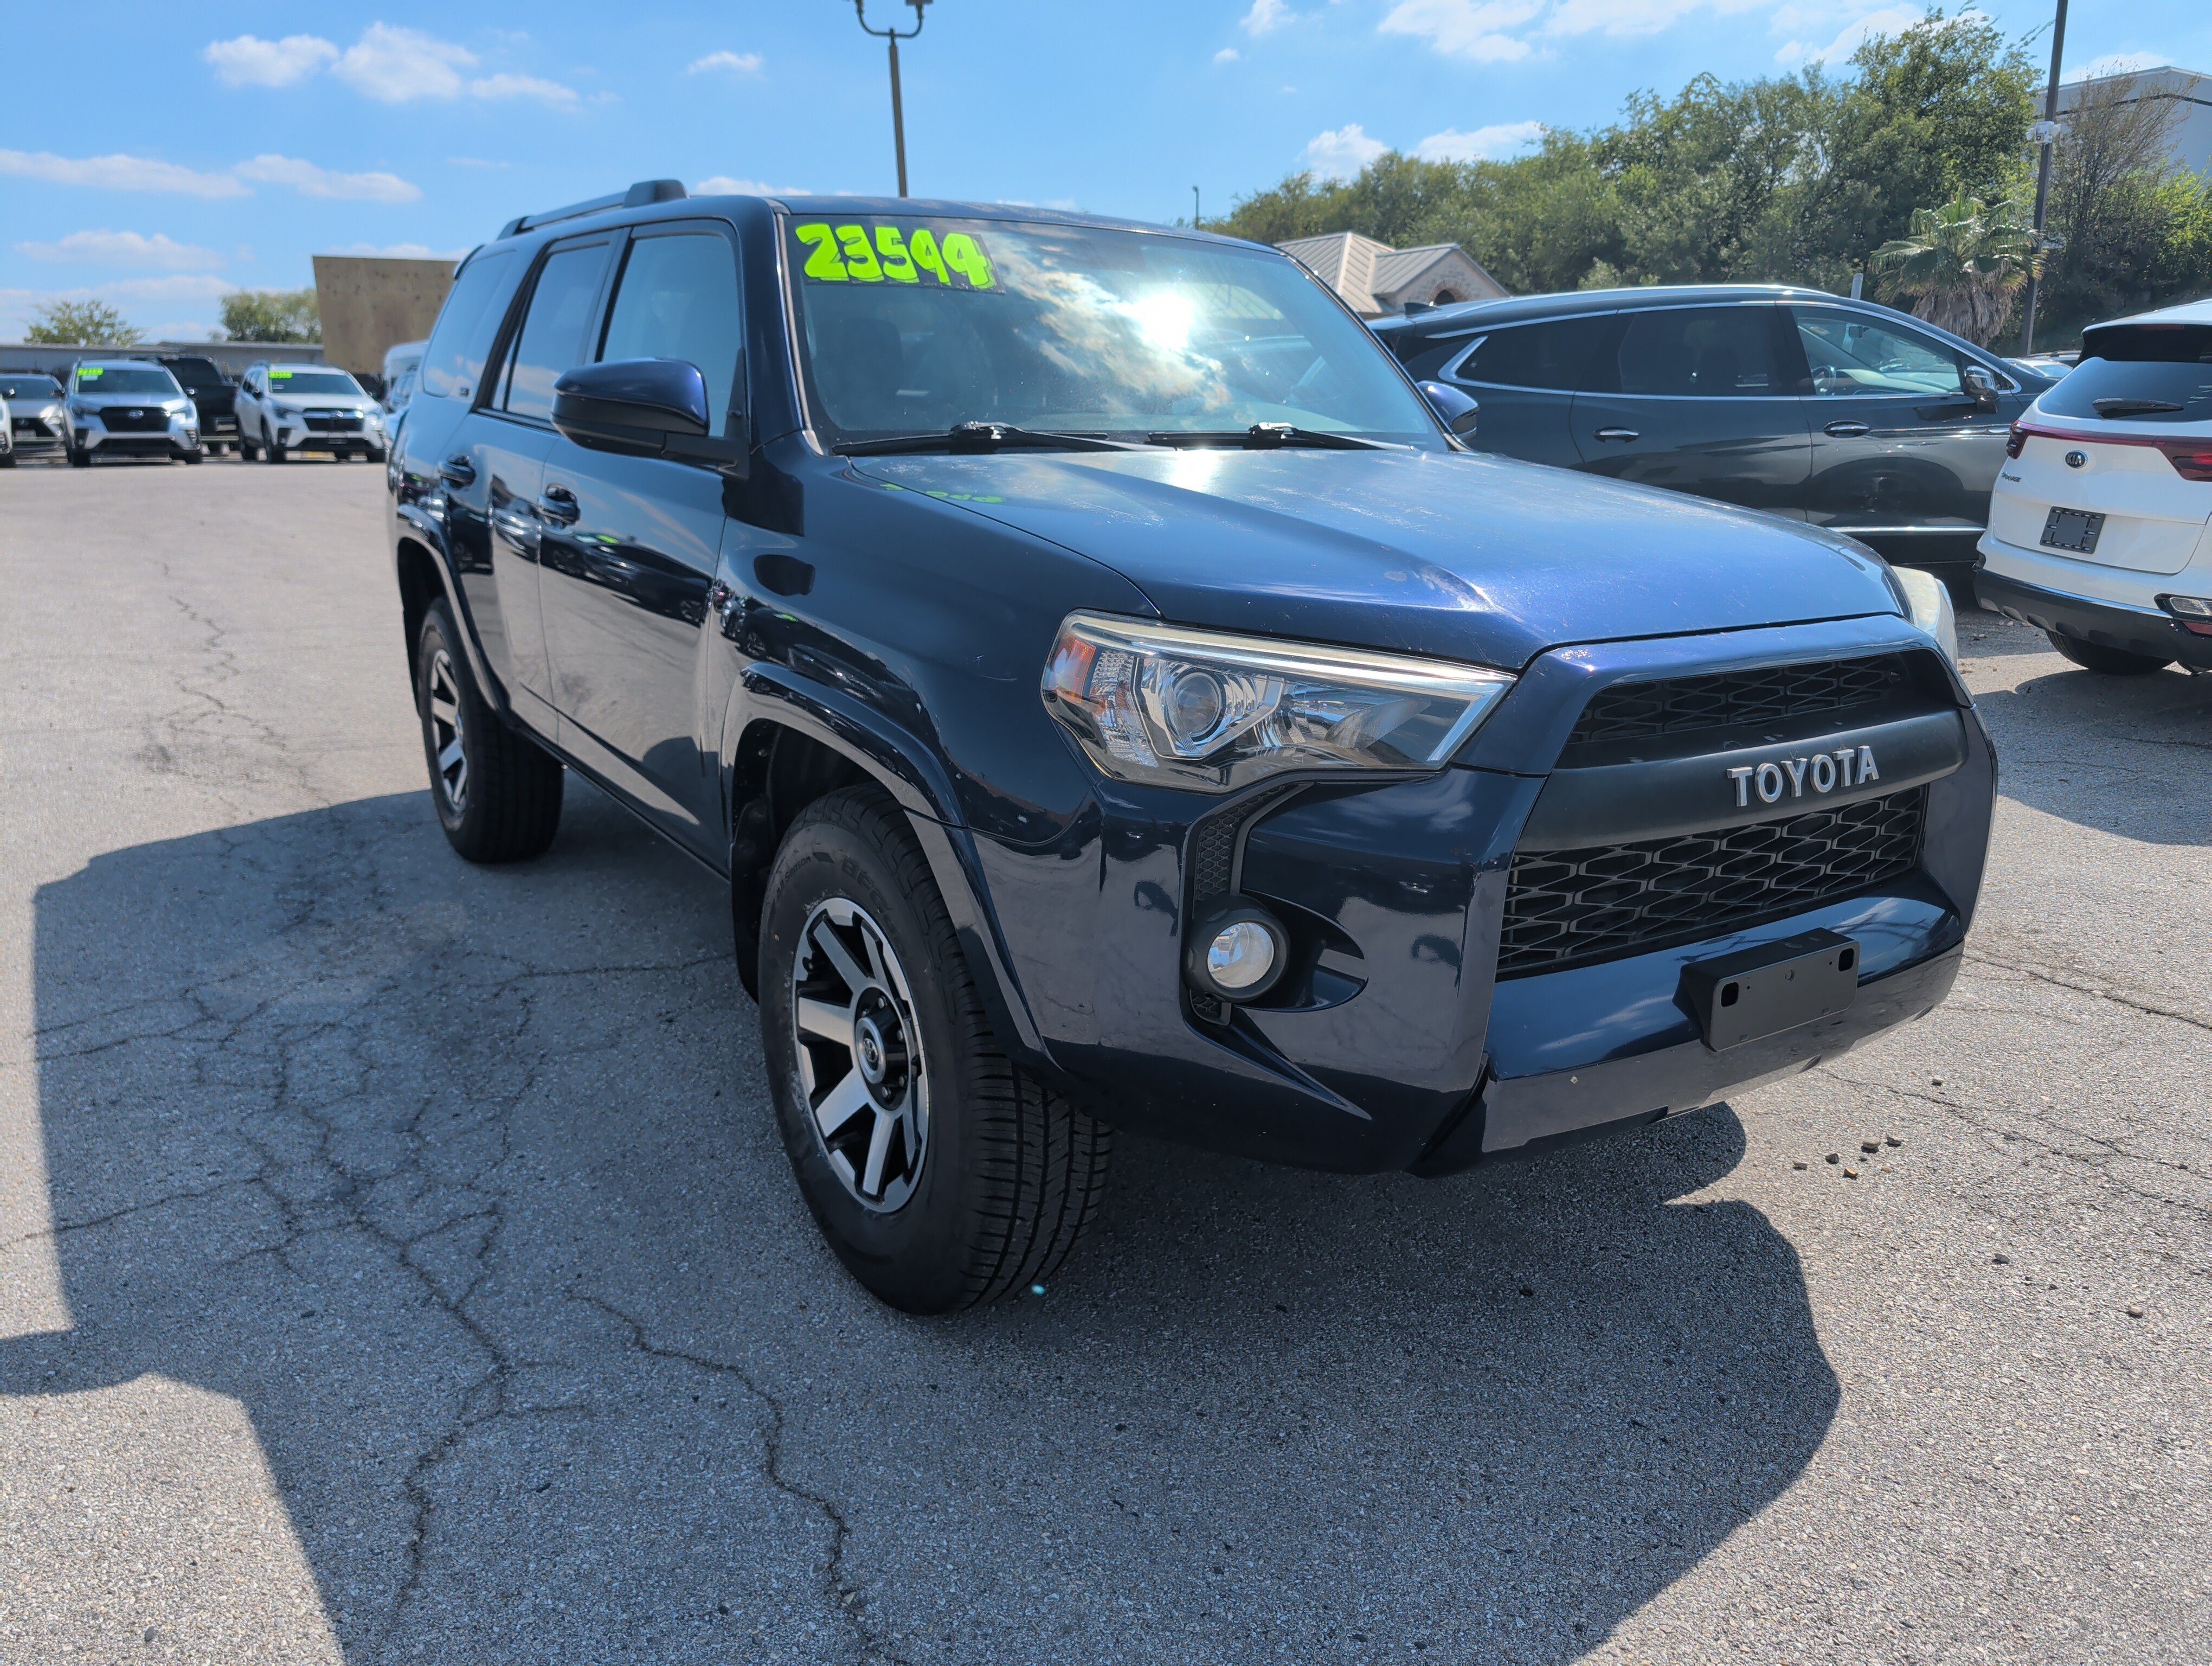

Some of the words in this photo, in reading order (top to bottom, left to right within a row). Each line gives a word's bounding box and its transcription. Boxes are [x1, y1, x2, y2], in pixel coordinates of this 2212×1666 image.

[2067, 454, 2082, 465] KIA
[1726, 745, 1880, 807] TOYOTA
[785, 856, 812, 883] Season
